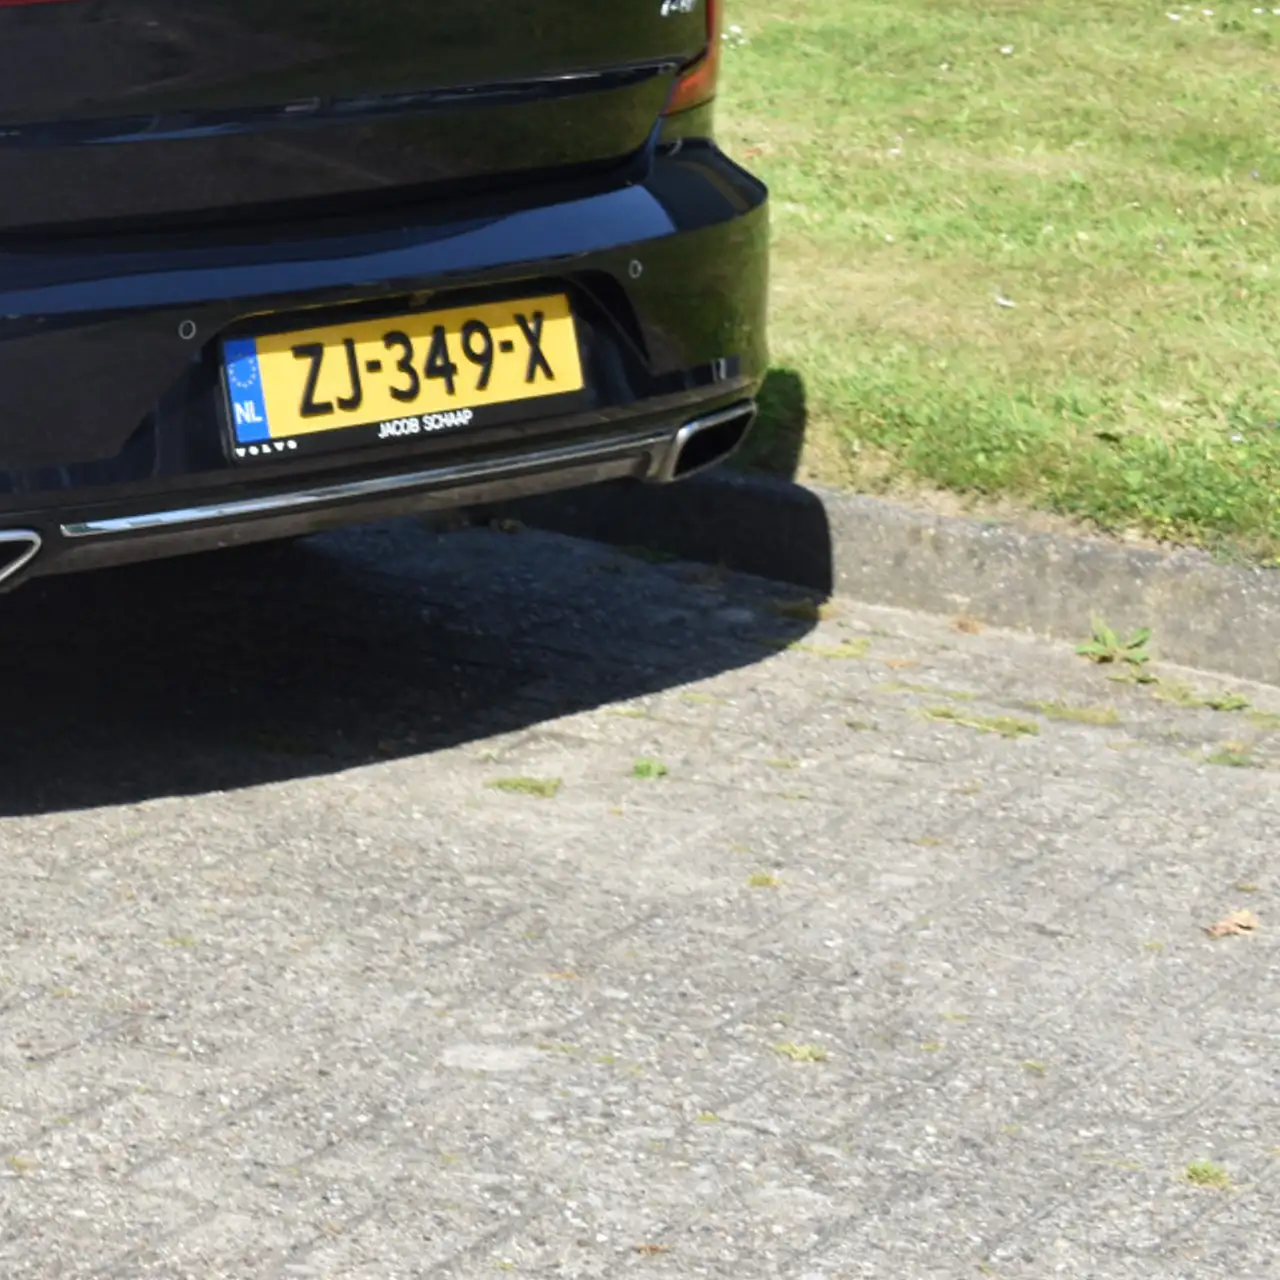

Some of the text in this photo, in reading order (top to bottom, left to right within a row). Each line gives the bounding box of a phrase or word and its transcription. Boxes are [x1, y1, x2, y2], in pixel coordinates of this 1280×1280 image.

[290, 310, 555, 419] ZJ-349-X
[233, 400, 264, 425] NL
[378, 408, 474, 439] JACOB SCHAAP
